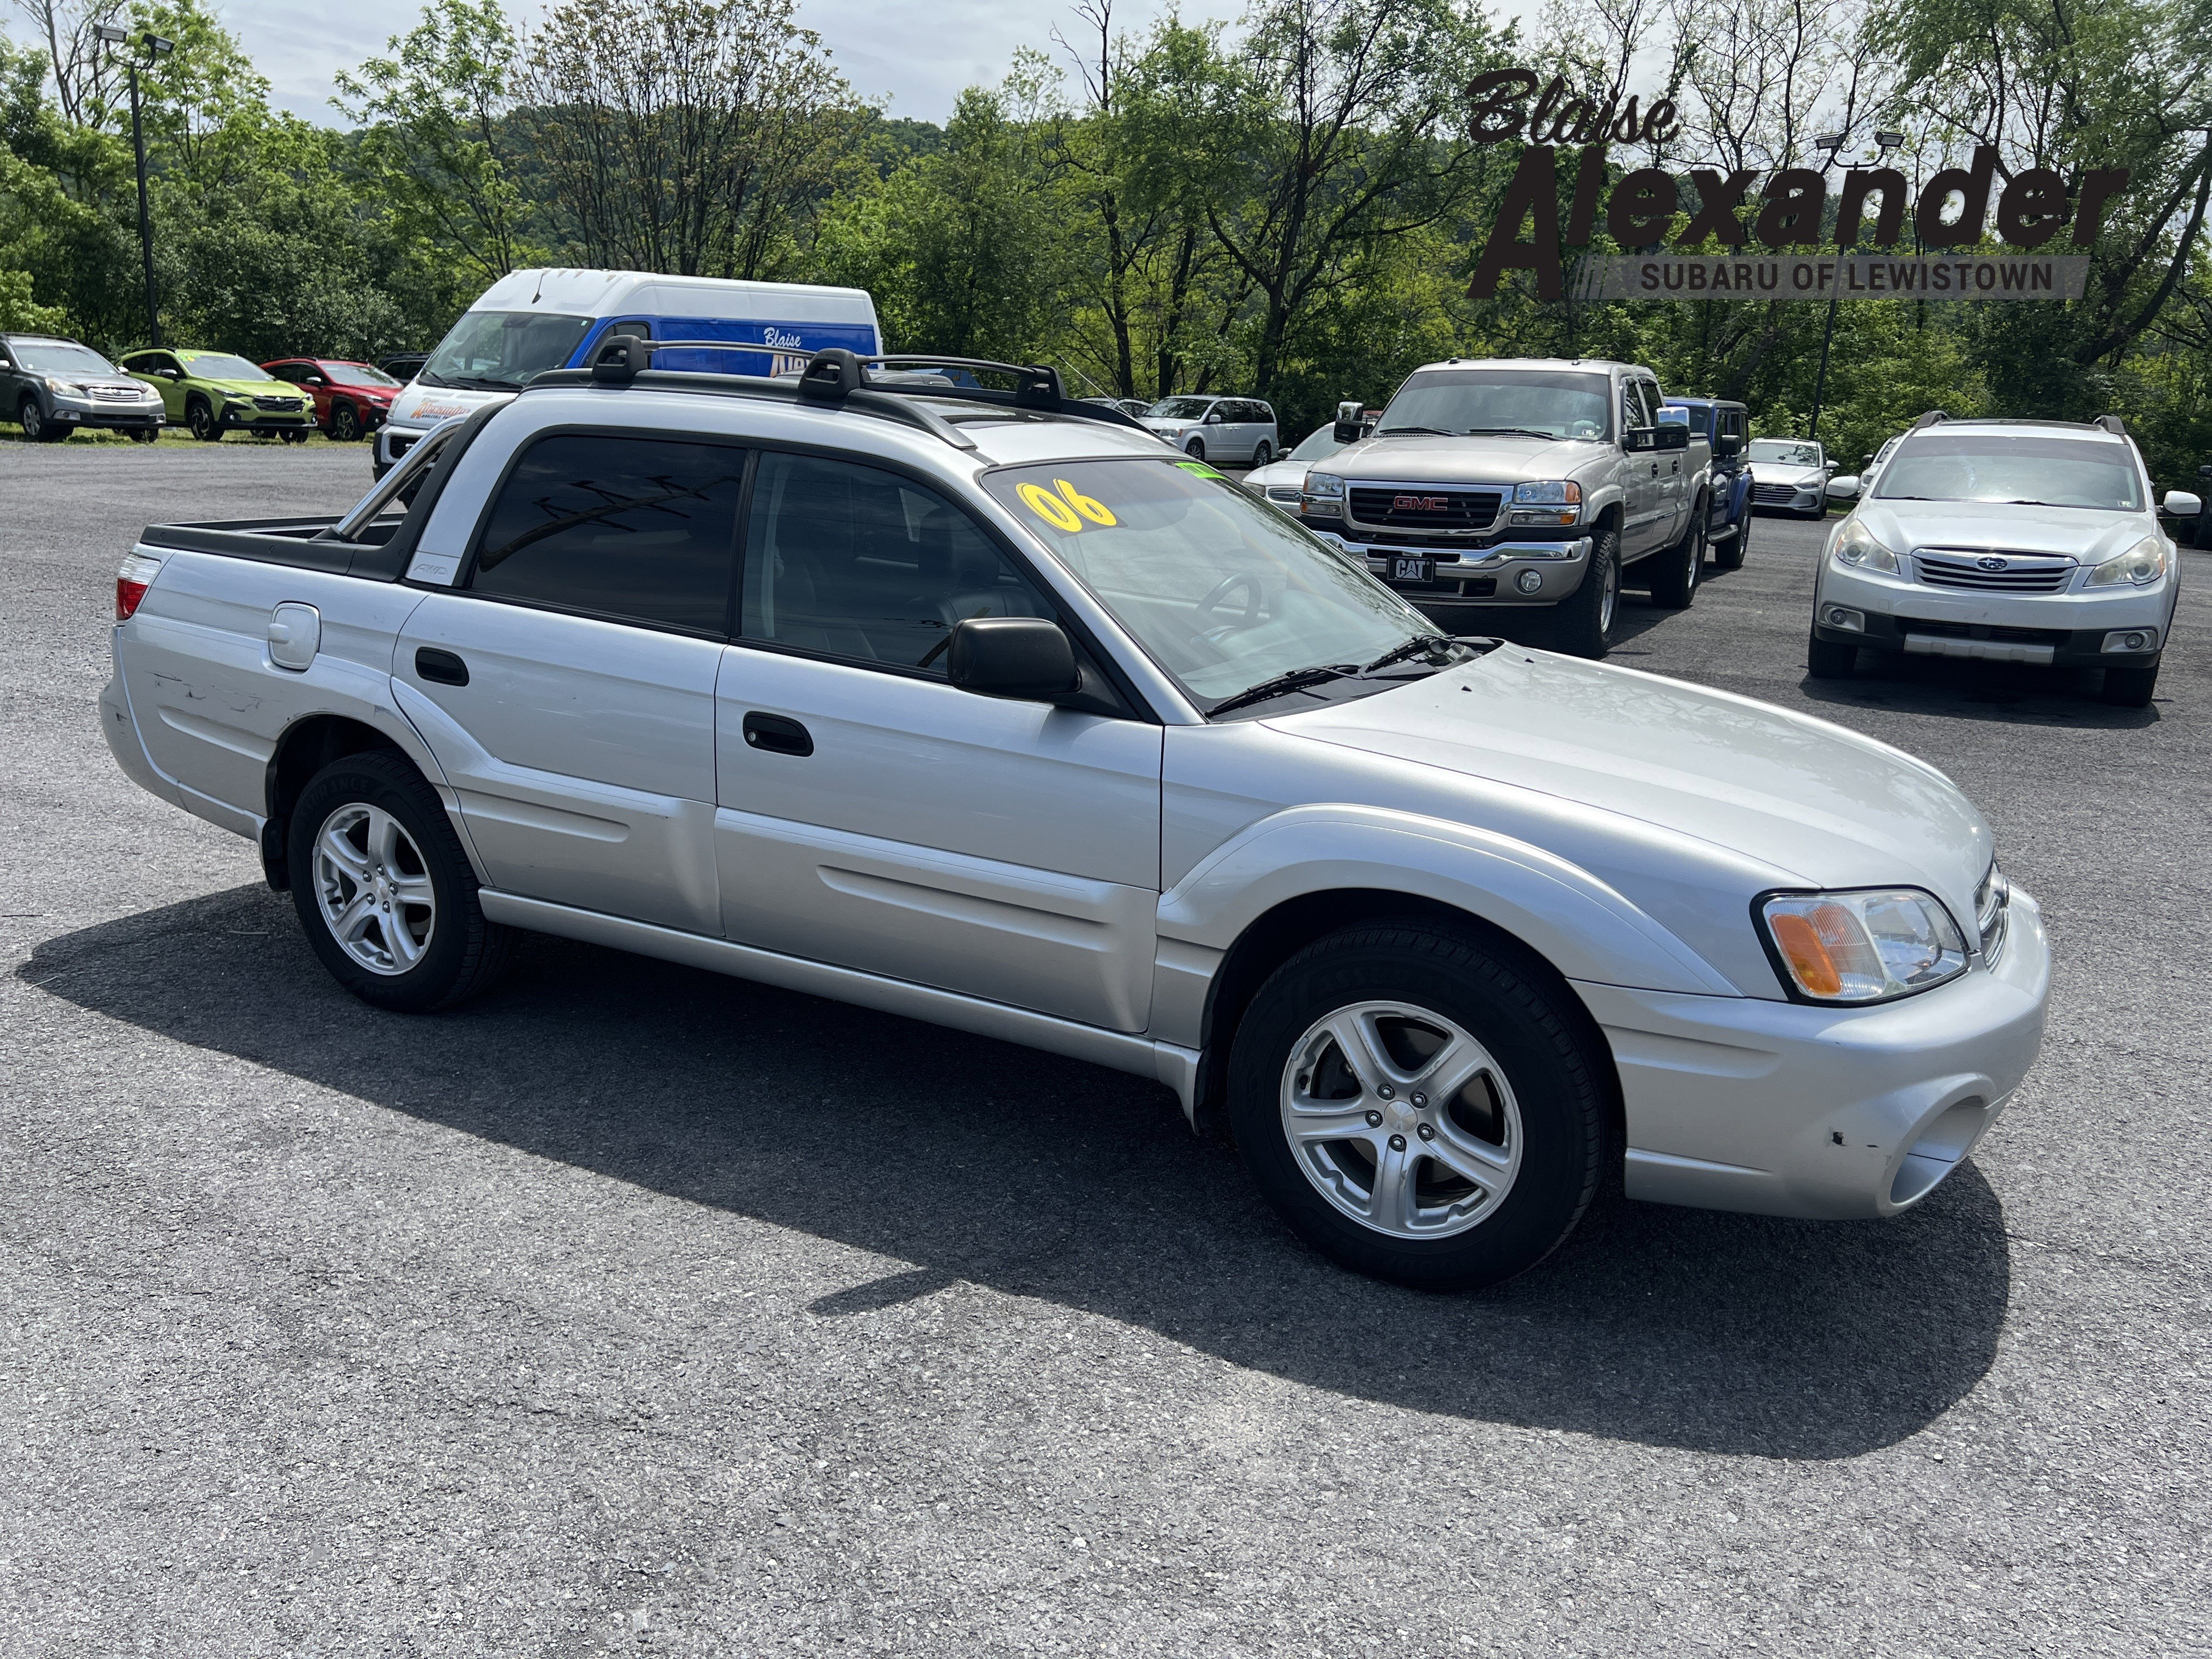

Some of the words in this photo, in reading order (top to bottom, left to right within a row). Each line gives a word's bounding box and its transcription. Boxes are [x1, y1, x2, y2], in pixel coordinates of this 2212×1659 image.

[764, 327, 801, 347] Blaise
[1015, 477, 1117, 533] 06
[1393, 495, 1448, 511] GMC
[1395, 559, 1426, 579] CAT
